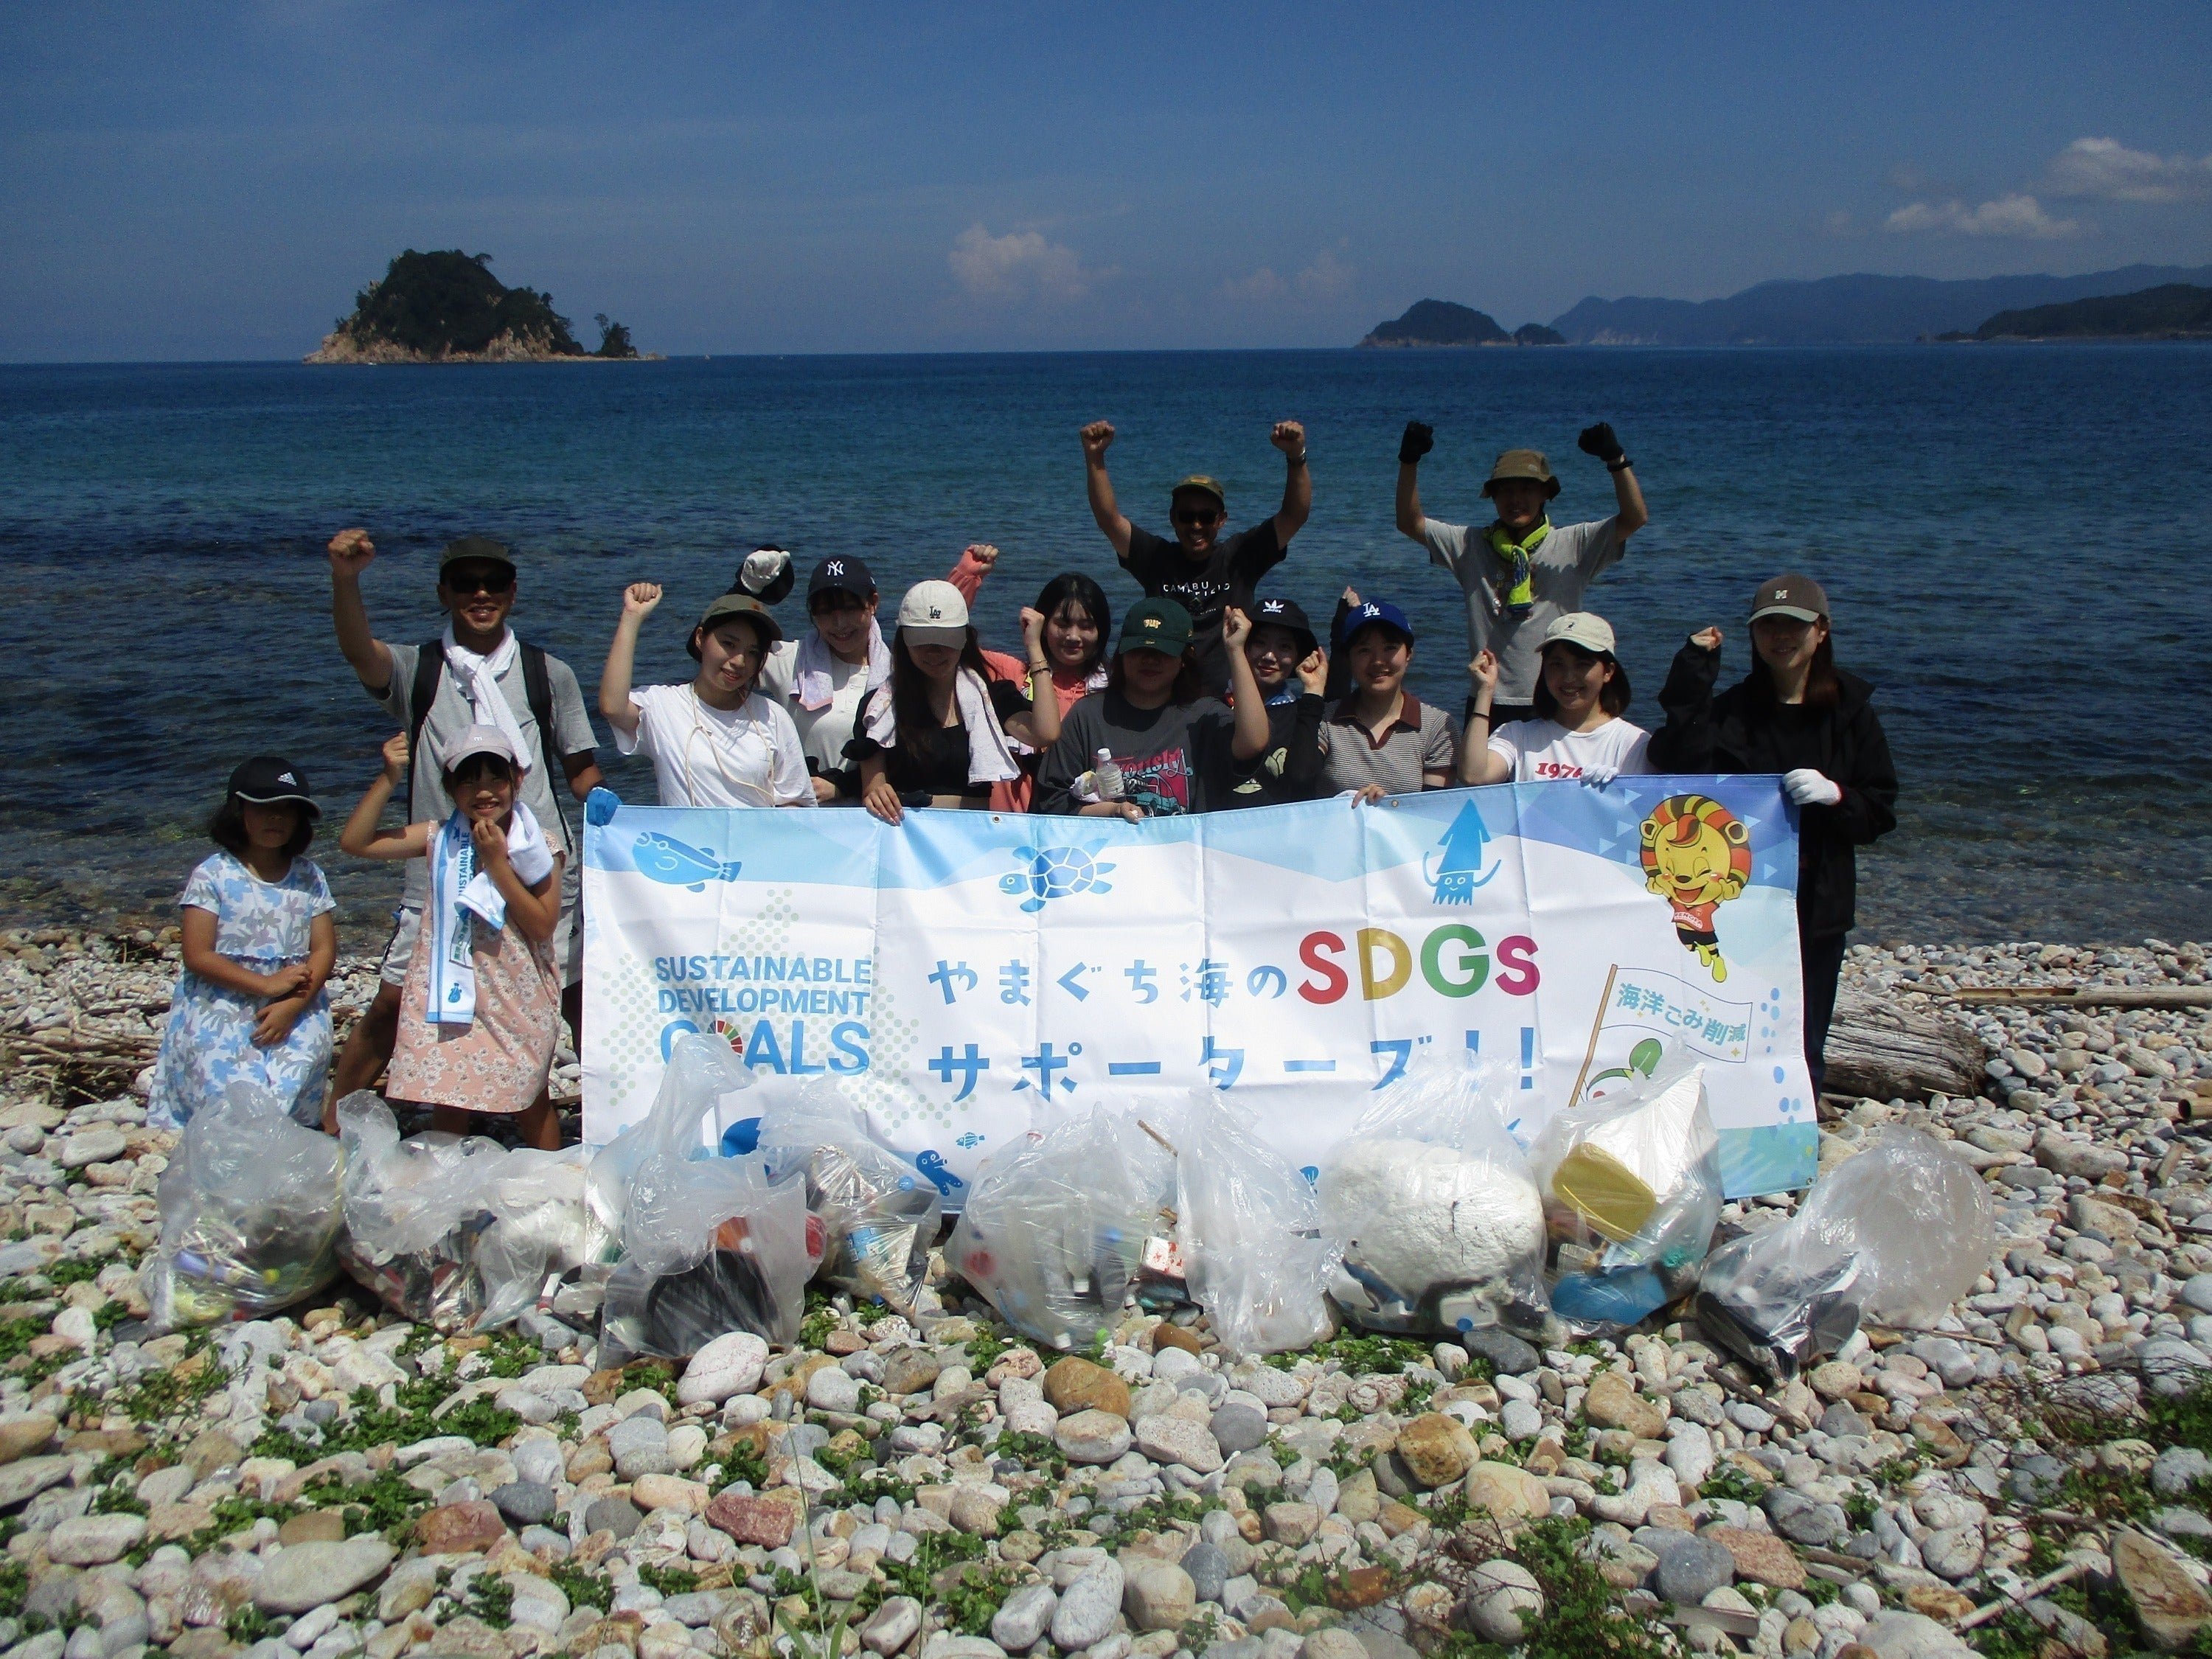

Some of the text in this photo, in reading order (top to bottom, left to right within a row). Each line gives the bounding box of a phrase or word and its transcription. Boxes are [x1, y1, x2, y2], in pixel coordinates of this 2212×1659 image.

[827, 560, 844, 576] NY
[1363, 602, 1381, 617] LA
[458, 832, 470, 896] USTAINABLE
[655, 956, 872, 984] SUSTAINABLE
[658, 987, 872, 1015] DEVELOPMENT
